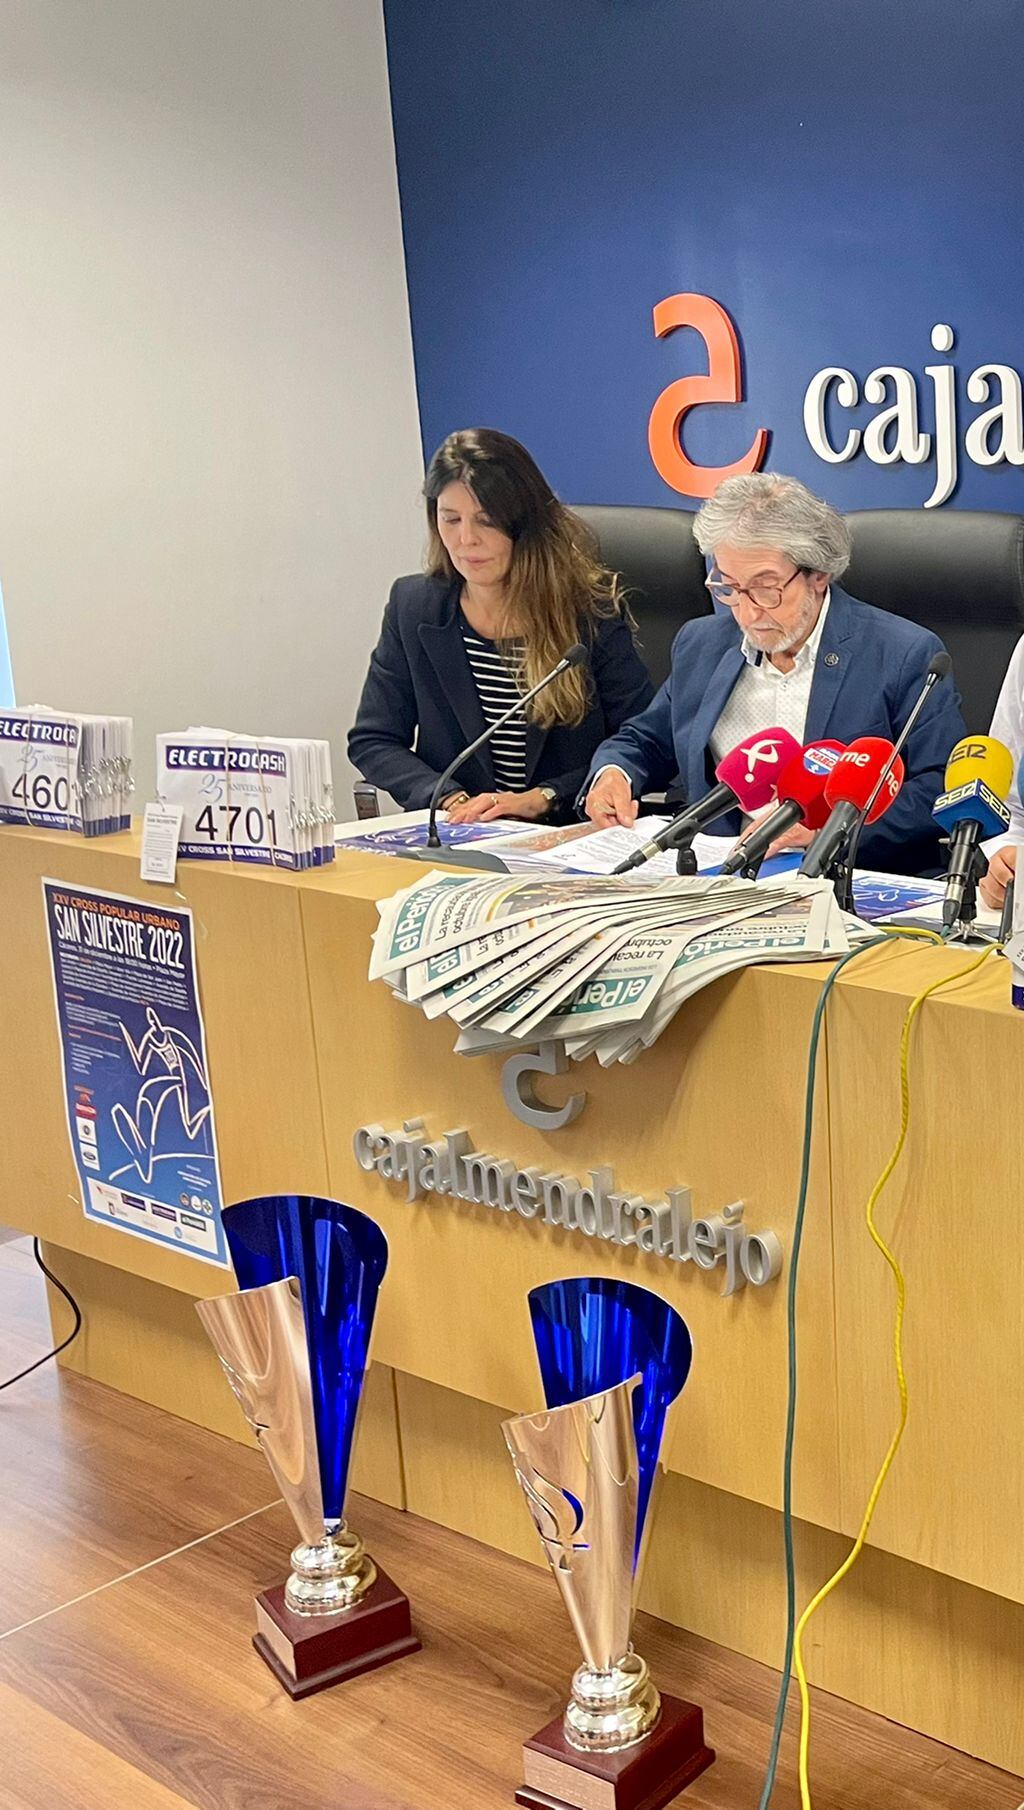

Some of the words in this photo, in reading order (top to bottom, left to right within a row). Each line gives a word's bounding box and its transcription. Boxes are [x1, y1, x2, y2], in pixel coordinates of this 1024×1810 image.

[0, 720, 77, 744] LECTROCA
[168, 749, 286, 772] ELECTROCASH
[808, 751, 836, 767] MARC
[949, 744, 987, 762] ER
[934, 782, 976, 811] SER
[979, 784, 1010, 824] SER
[195, 805, 277, 846] 4701
[51, 891, 69, 905] XXV
[70, 896, 97, 911] CROSS
[98, 902, 140, 922] POPULAR
[141, 911, 180, 931] URBANO
[53, 902, 81, 943] SAN
[81, 909, 147, 959] SILVESTRE
[146, 924, 186, 970] 2022
[352, 1116, 784, 1298] cajalmendralejo
